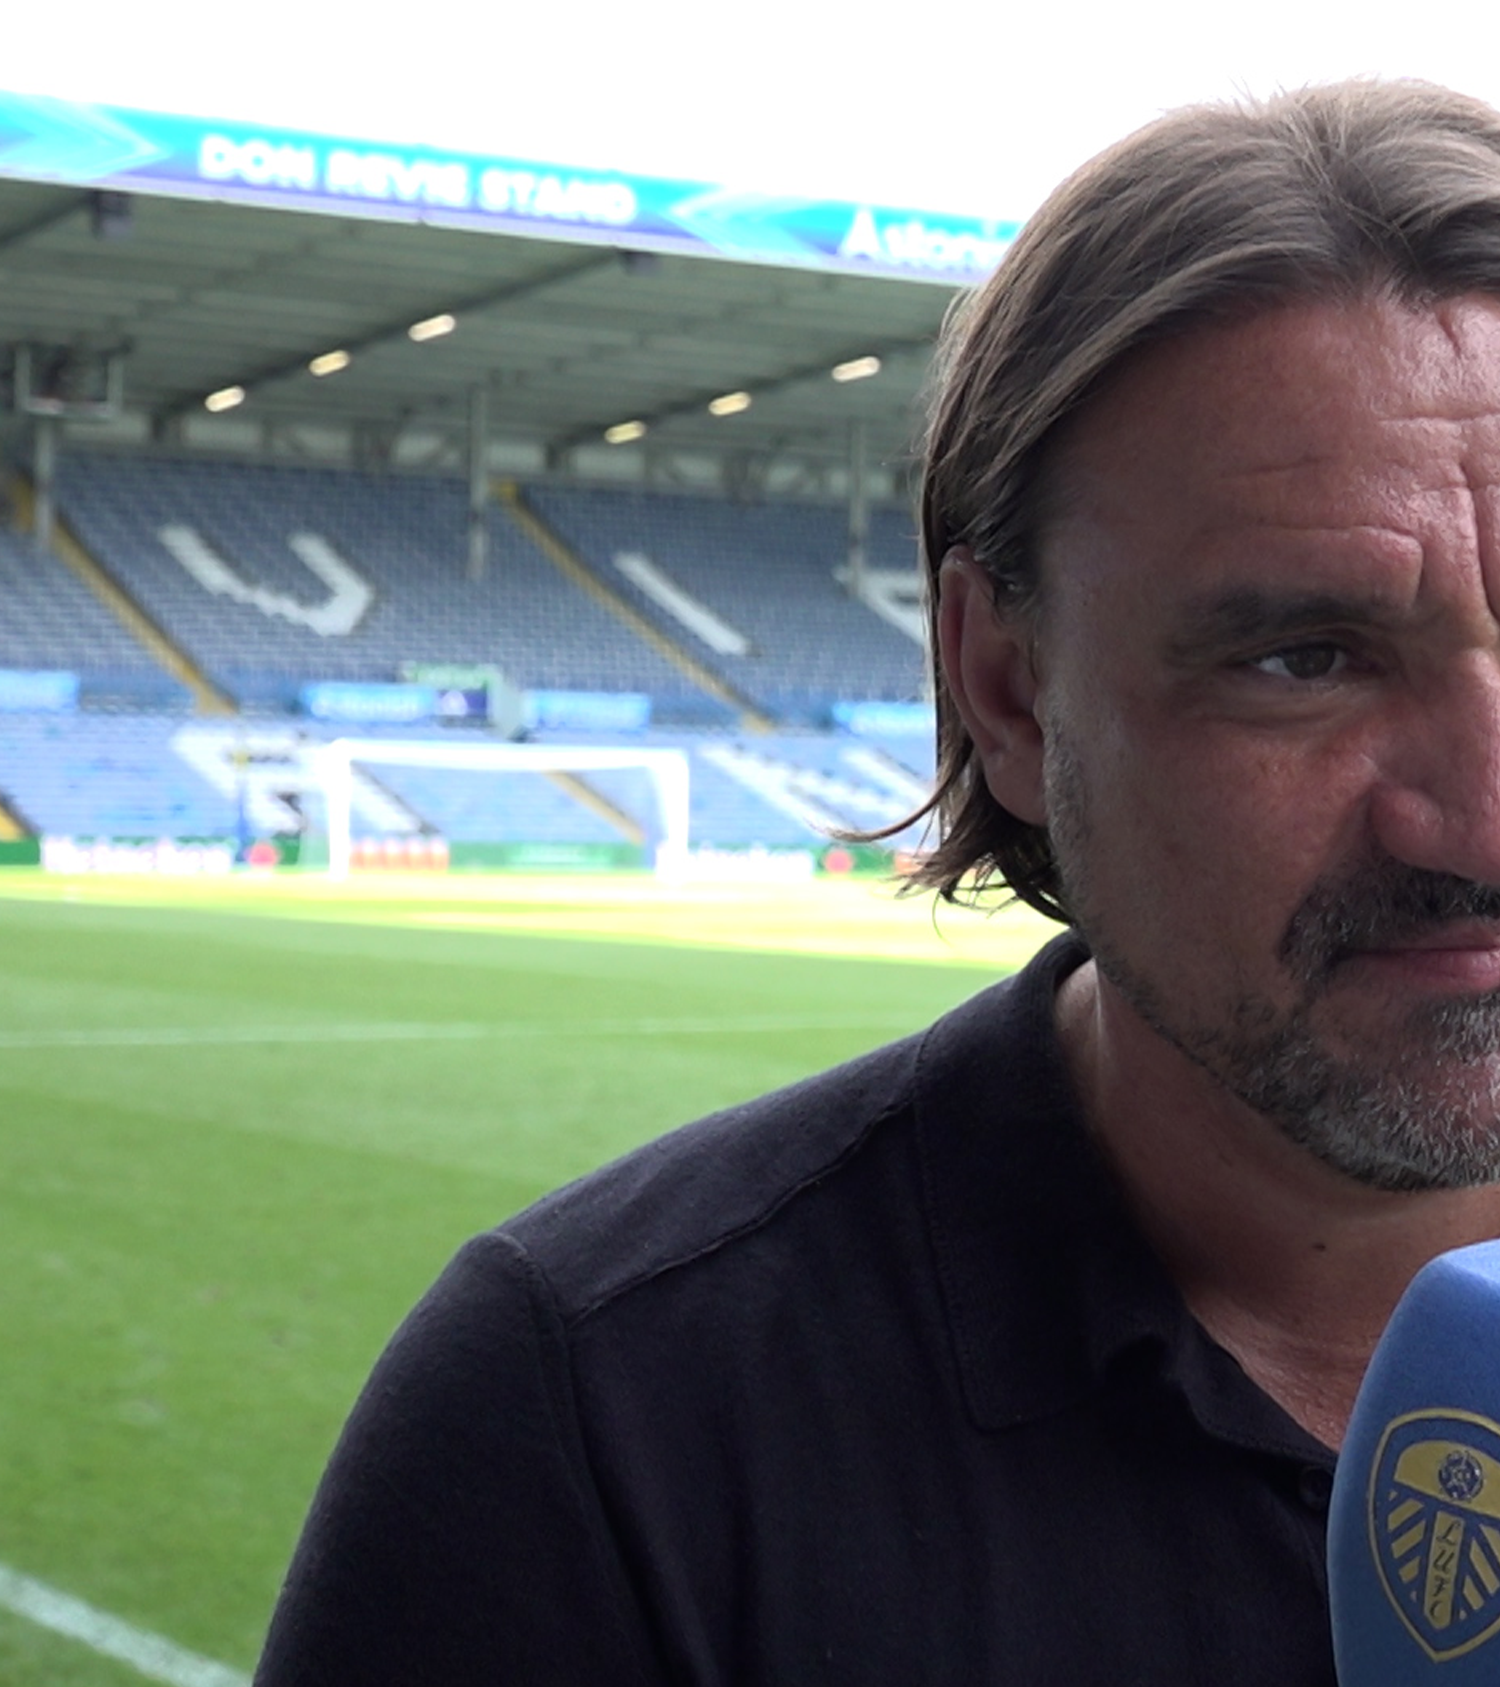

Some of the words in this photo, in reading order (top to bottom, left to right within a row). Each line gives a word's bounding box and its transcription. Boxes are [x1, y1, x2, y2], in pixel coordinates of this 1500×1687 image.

[199, 134, 315, 189] DON
[324, 149, 470, 208] REVIE
[478, 167, 638, 225] STAND
